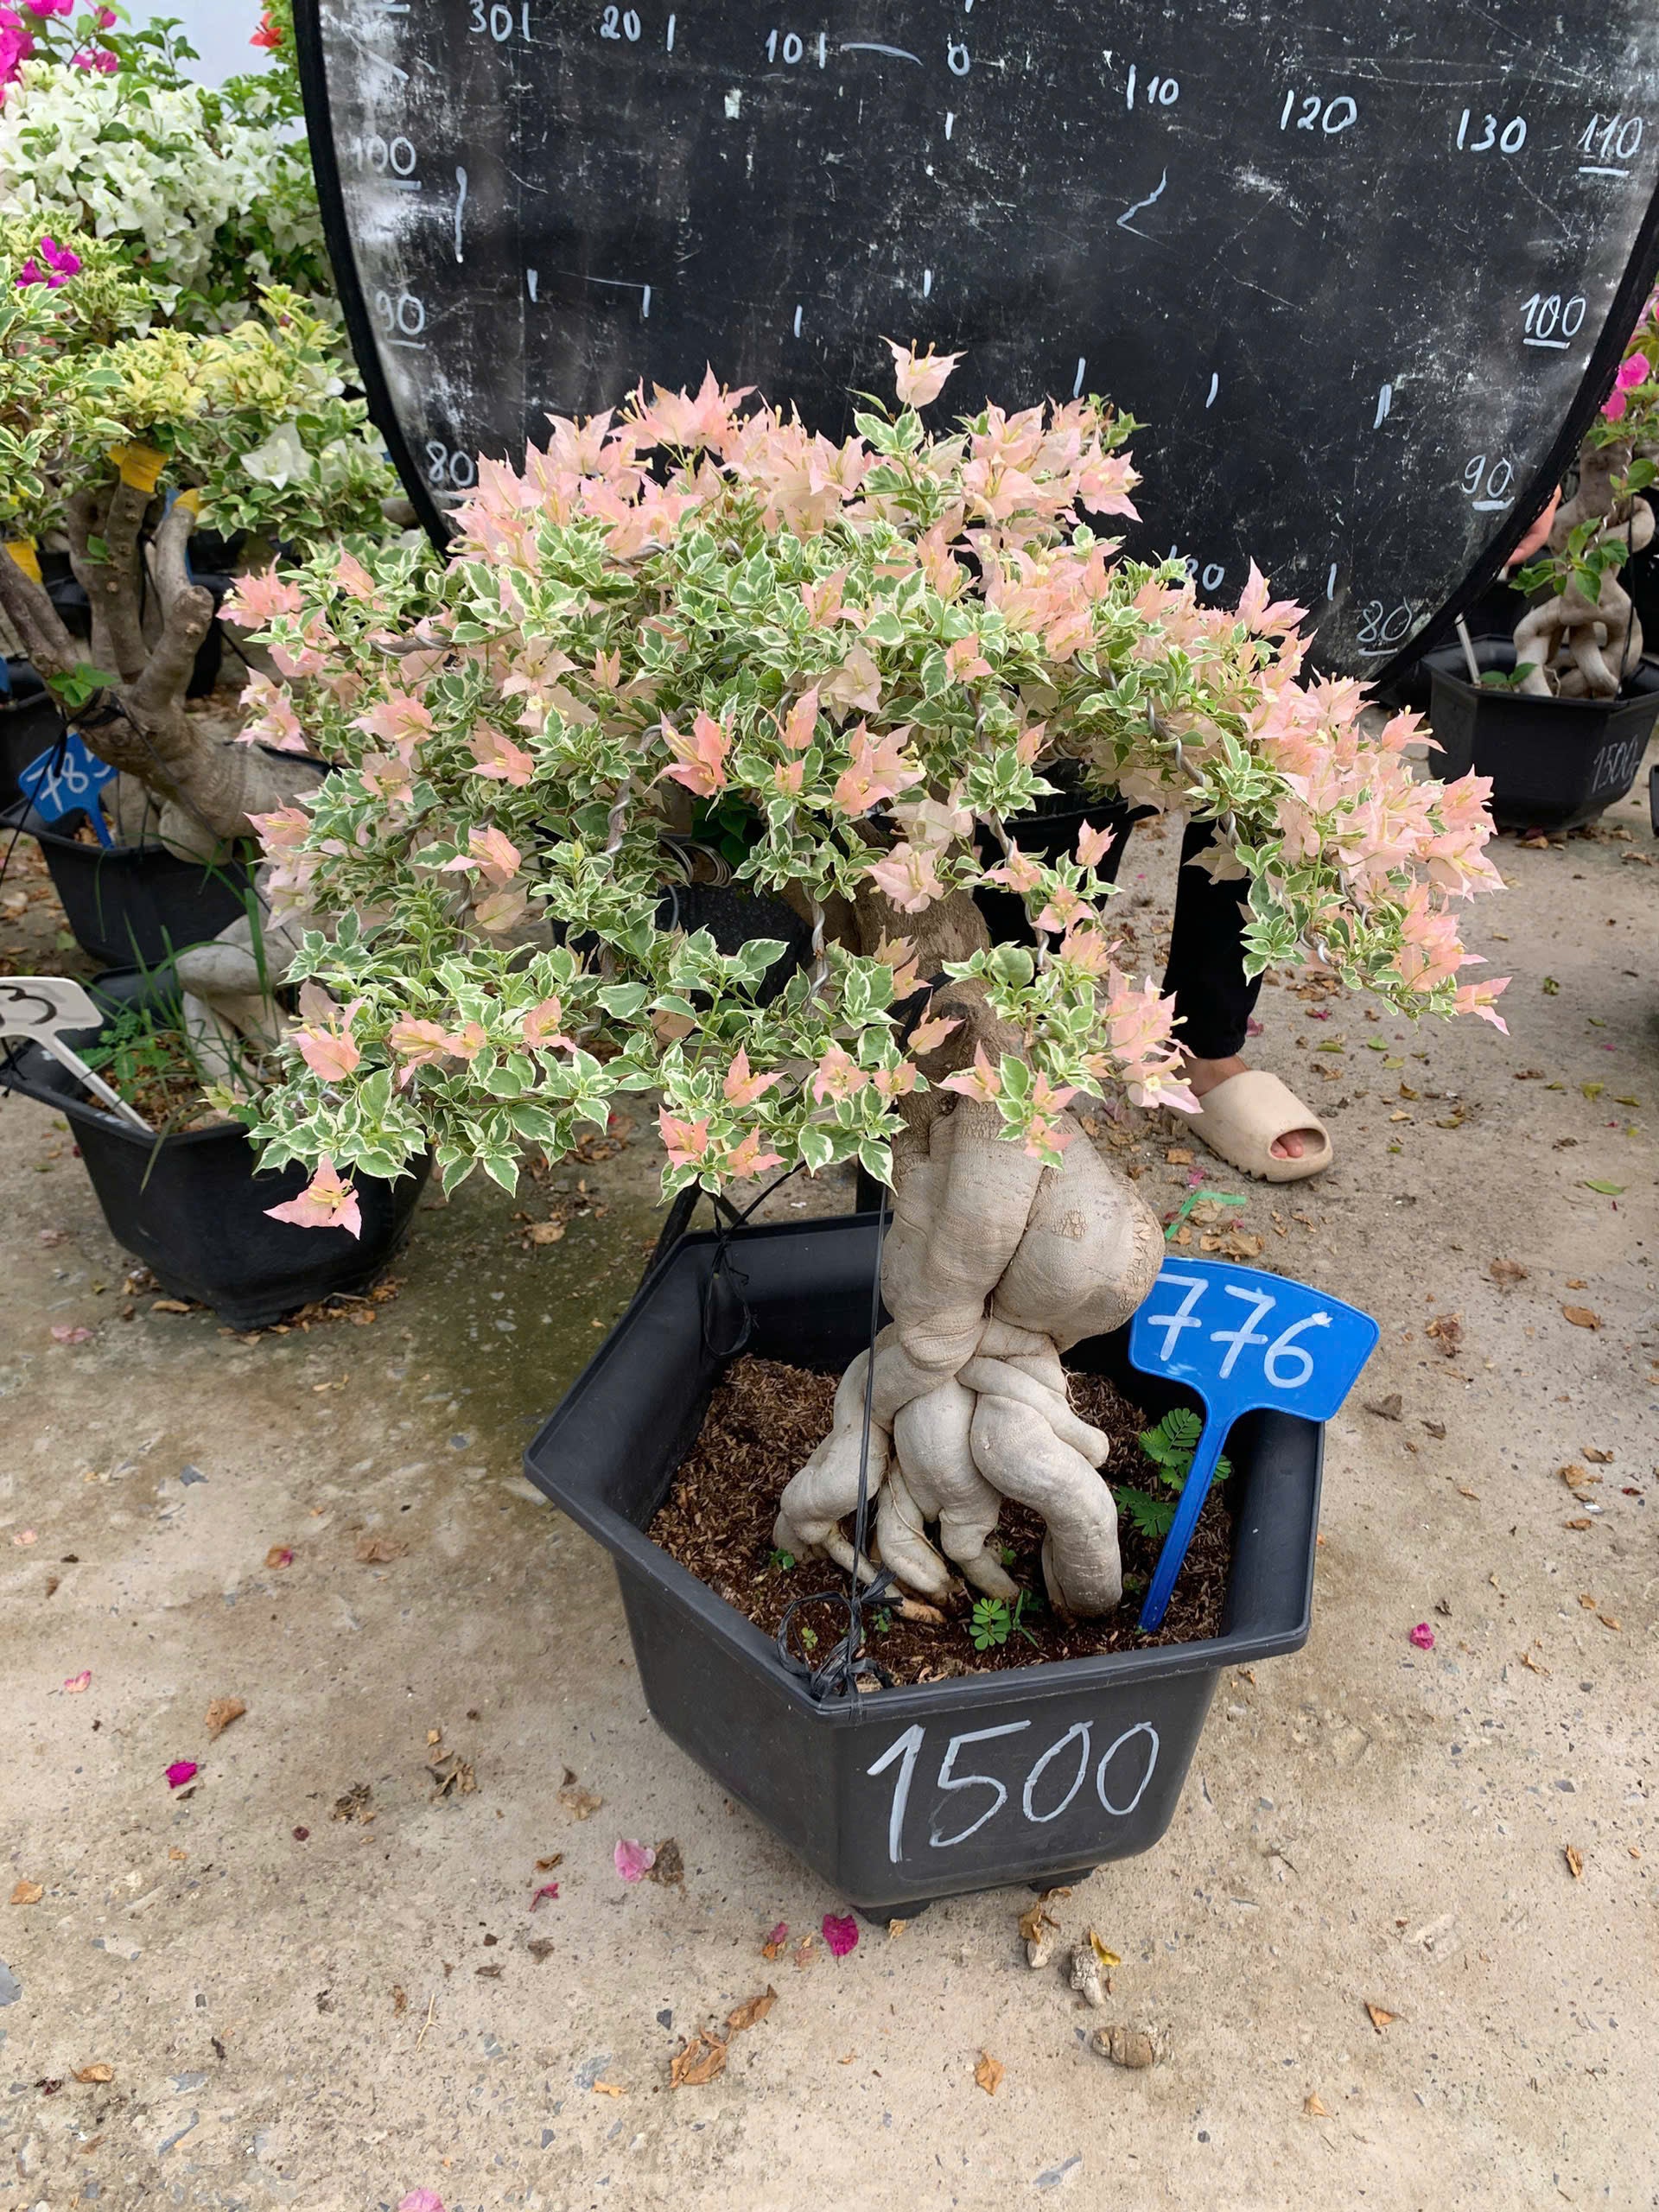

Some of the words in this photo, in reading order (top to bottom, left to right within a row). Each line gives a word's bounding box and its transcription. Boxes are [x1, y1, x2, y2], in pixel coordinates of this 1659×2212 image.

[947, 44, 970, 76] 0
[1577, 113, 1643, 159] 110
[375, 289, 426, 335] 90
[1520, 293, 1586, 340] 100
[425, 440, 474, 486] 80
[1460, 454, 1515, 499] 90
[1357, 597, 1413, 643] 80
[1146, 1272, 1333, 1389] 776
[867, 1719, 1160, 1864] 1500
